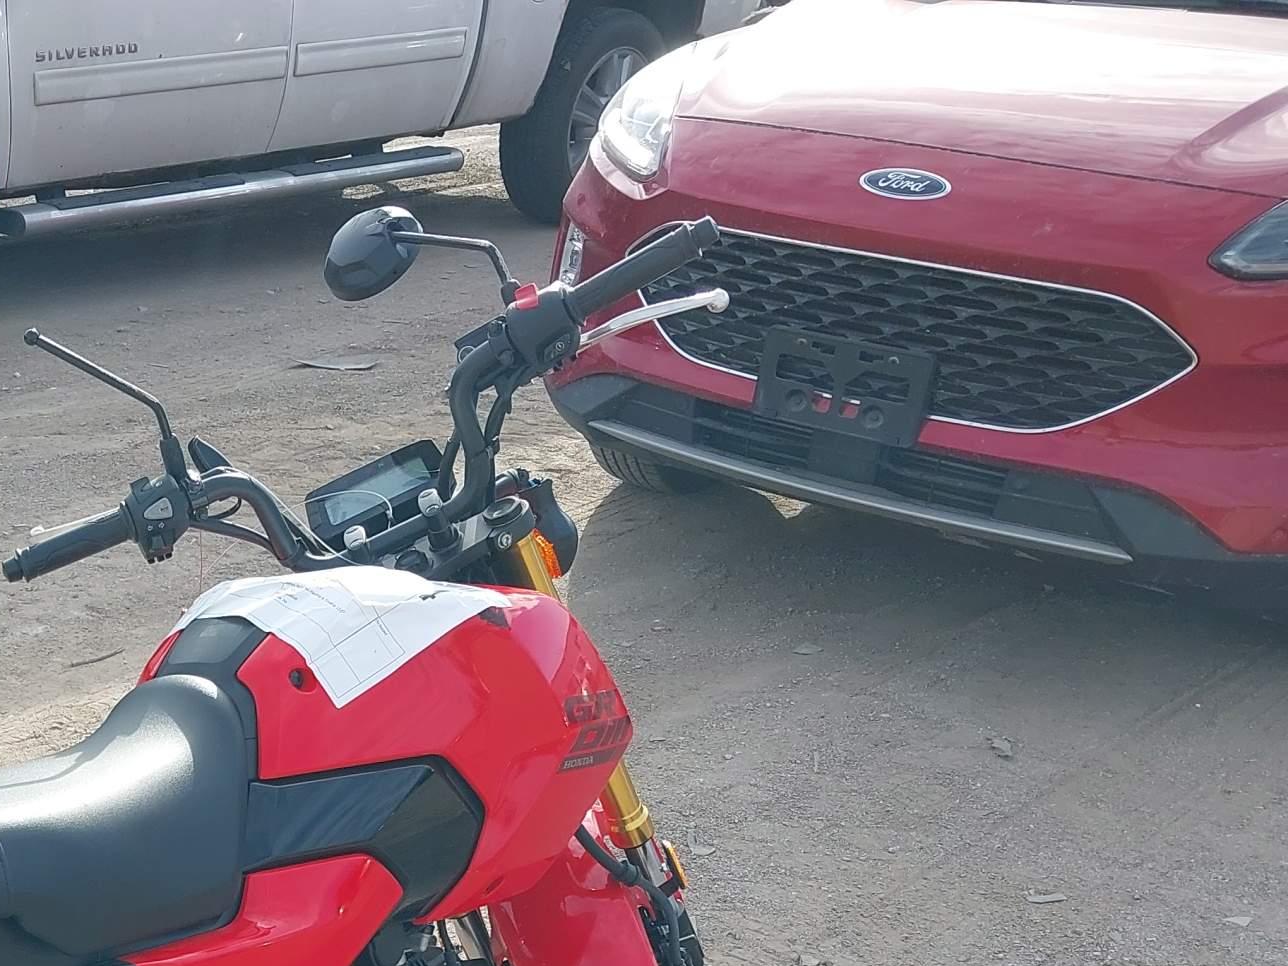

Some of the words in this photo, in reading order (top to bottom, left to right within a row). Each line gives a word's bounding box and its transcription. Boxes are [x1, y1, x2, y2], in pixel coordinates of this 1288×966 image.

[35, 42, 138, 62] SILVERADO
[878, 171, 931, 192] Ford
[563, 756, 594, 769] HONDA
